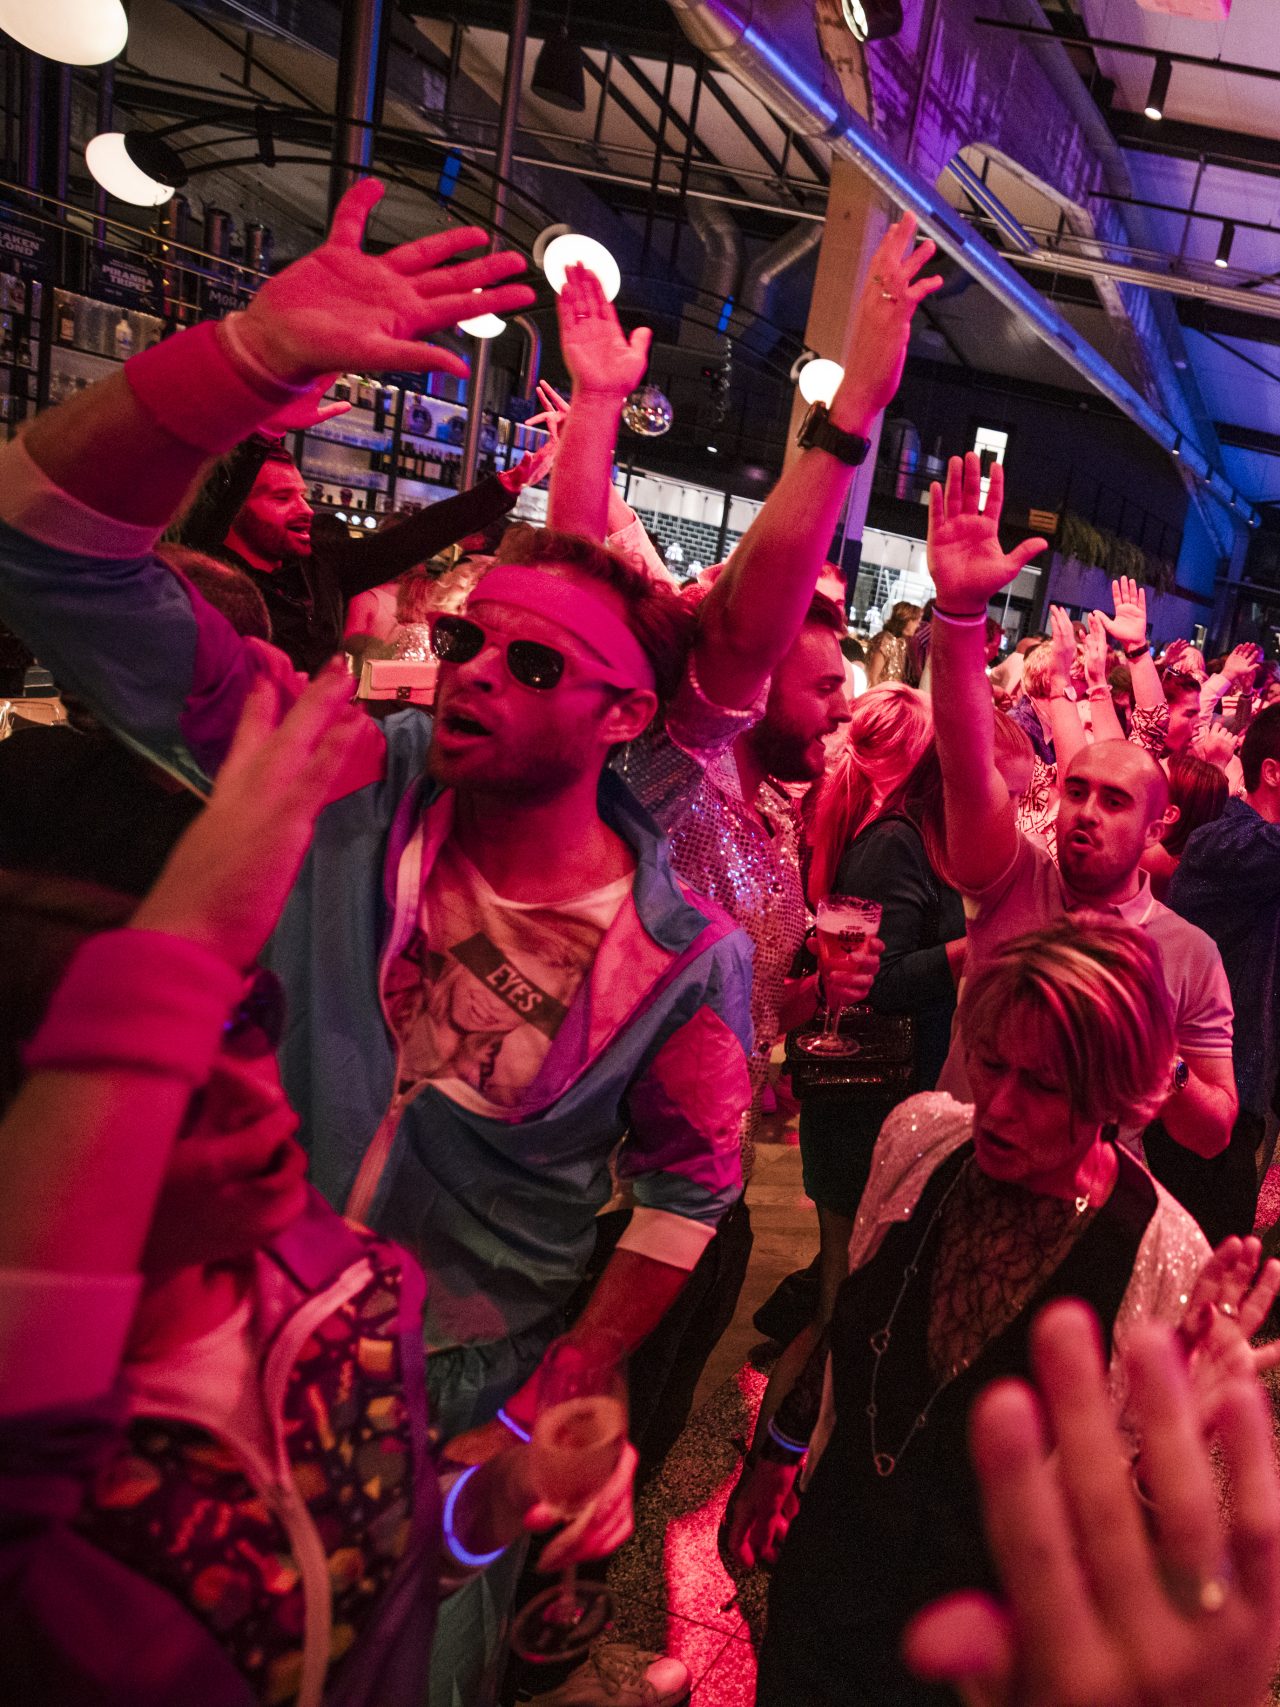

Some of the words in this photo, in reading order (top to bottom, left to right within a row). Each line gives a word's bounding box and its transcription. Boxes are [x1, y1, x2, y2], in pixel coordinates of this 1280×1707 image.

[0, 231, 39, 251] AKEN
[0, 241, 34, 257] LOND
[102, 264, 154, 287] PIRANHA
[485, 963, 543, 1013] EYES
